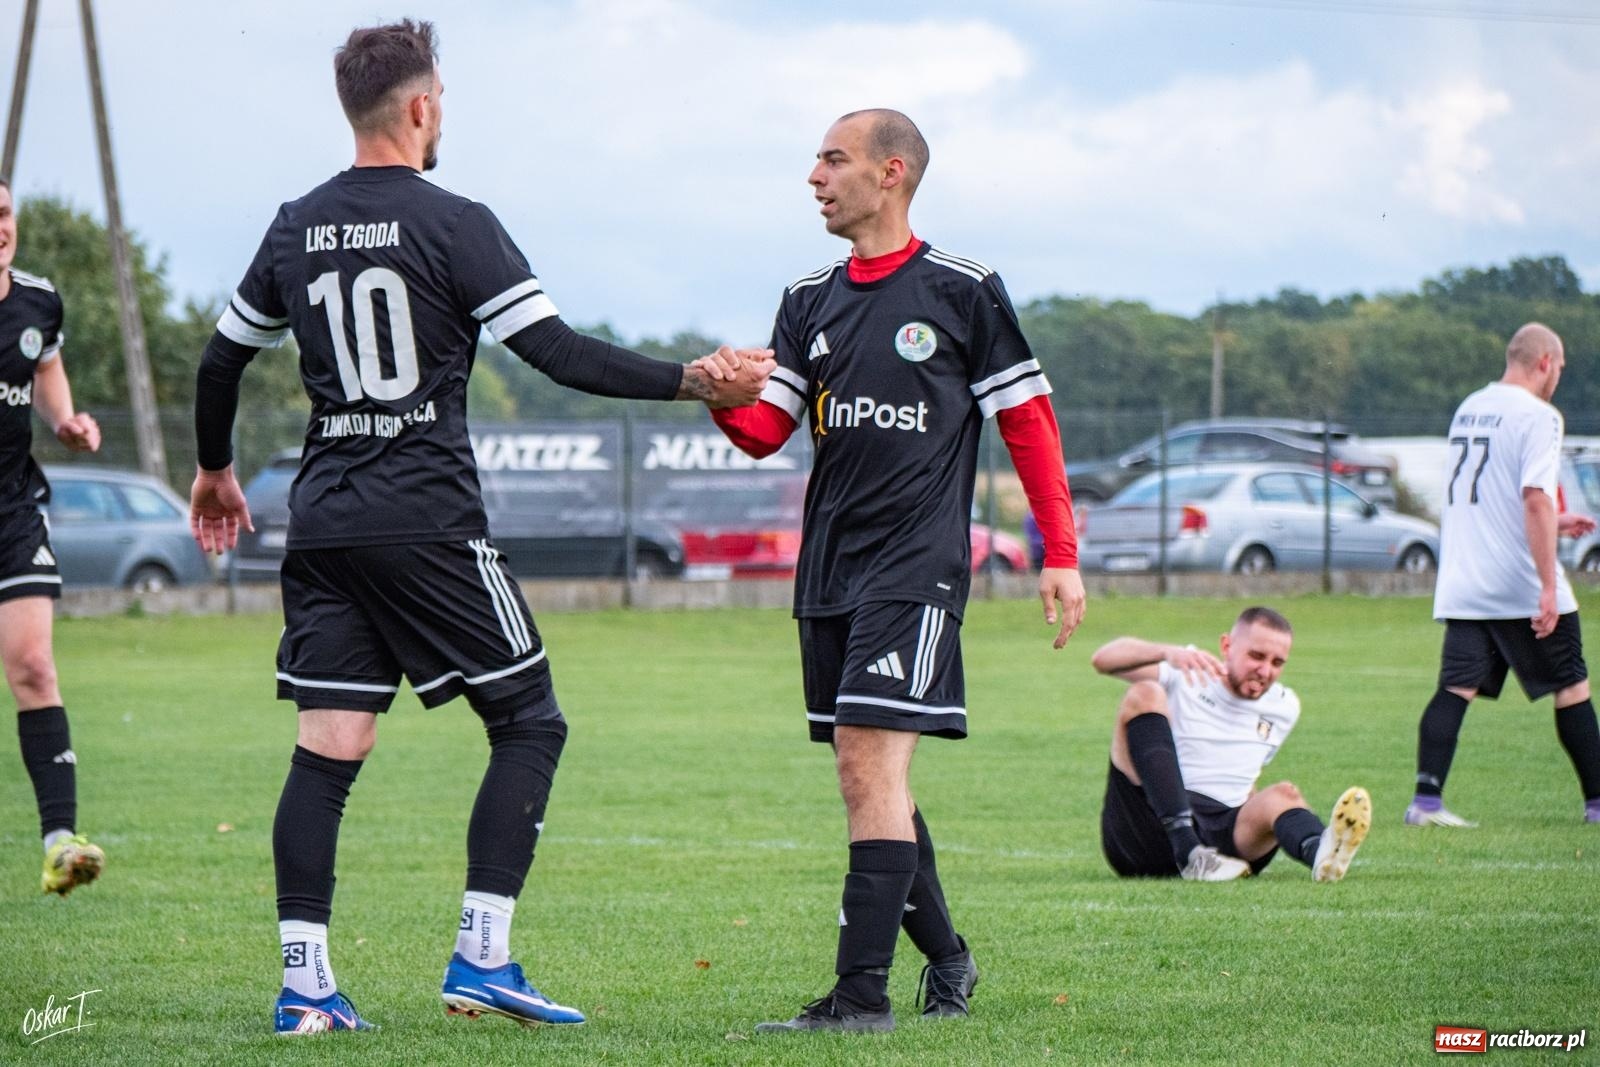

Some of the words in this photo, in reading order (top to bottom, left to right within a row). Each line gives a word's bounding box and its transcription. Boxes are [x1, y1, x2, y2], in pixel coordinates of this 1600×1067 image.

[306, 224, 337, 253] LKS
[342, 221, 400, 250] ZGODA
[307, 267, 420, 401] 10
[828, 396, 929, 433] InPost
[1448, 436, 1490, 506] 77
[314, 943, 328, 989] ALLSOCKS
